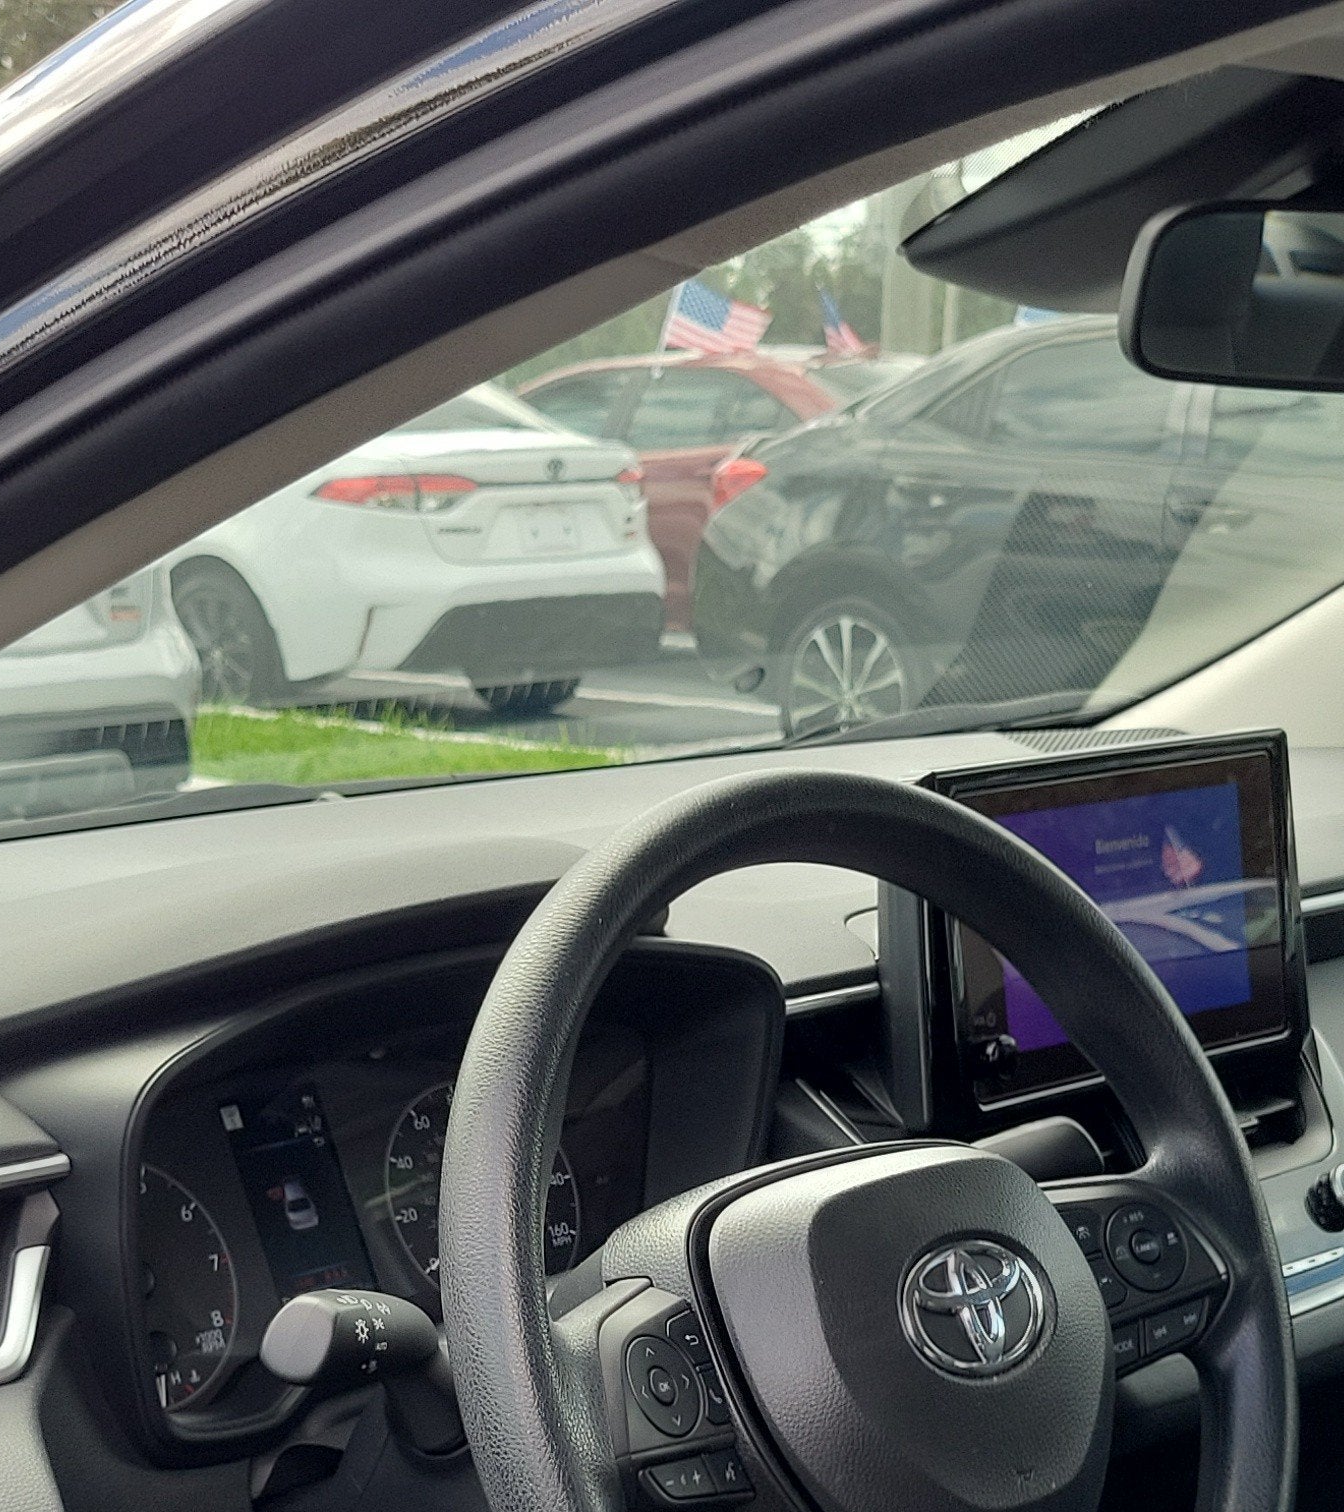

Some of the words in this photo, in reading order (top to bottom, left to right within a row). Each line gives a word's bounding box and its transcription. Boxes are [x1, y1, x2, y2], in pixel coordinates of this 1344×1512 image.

[414, 1115, 430, 1131] 60
[398, 1156, 414, 1170] 40
[181, 1205, 193, 1222] 6
[401, 1208, 418, 1223] 20
[548, 1222, 568, 1237] 160
[209, 1253, 219, 1272] 7
[211, 1310, 224, 1327] 8
[170, 1371, 182, 1386] H
[659, 1381, 670, 1392] OK
